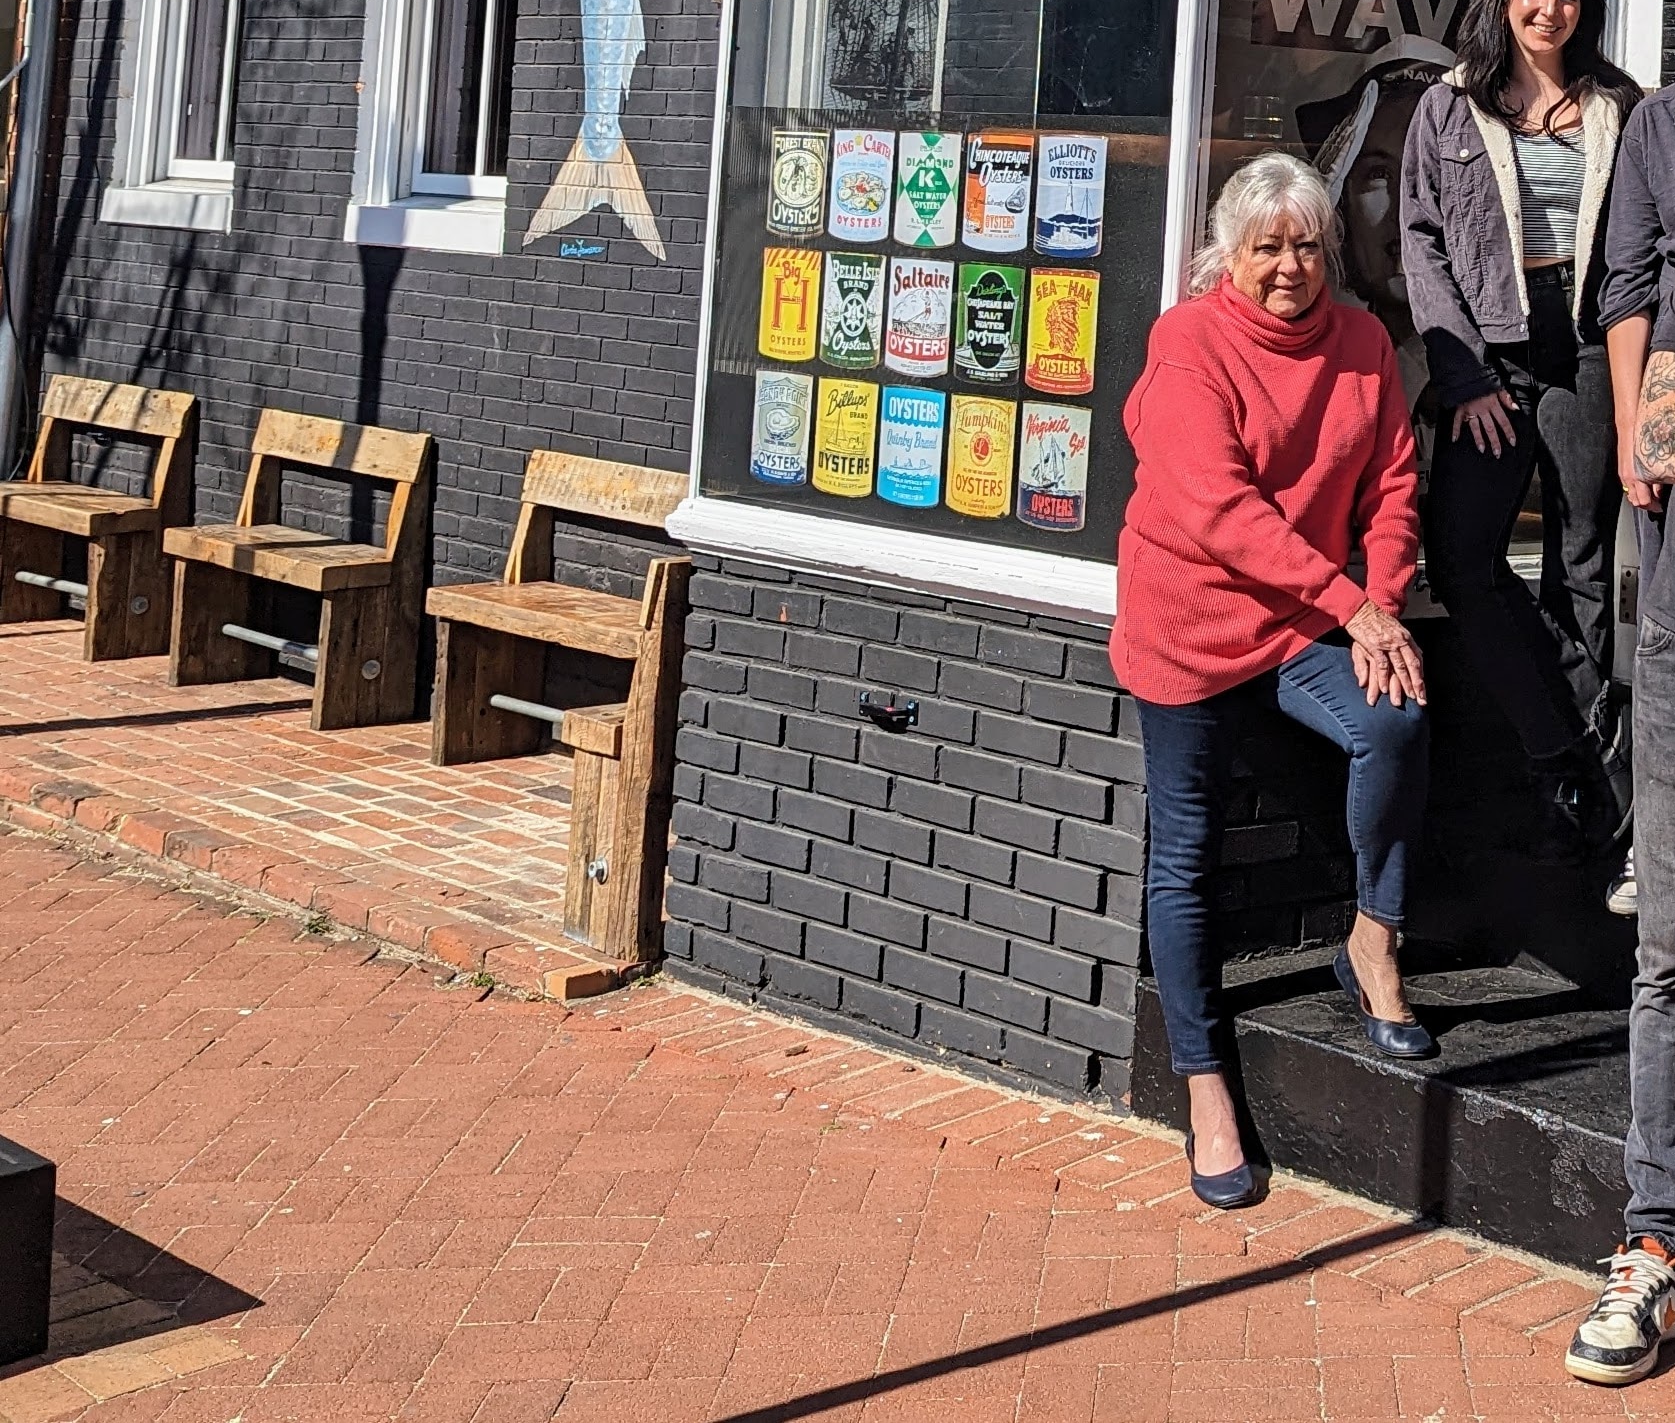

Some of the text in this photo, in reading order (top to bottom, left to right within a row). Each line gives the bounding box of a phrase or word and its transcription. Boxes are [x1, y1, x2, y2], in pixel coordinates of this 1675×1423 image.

[836, 139, 855, 158] KING
[1047, 143, 1098, 164] ELLIOTT'S
[906, 156, 954, 169] DIAMOND
[918, 170, 936, 188] K
[1050, 167, 1094, 180] OYSTERS
[772, 199, 820, 225] OYSTERS
[836, 214, 882, 228] OYSTERS
[985, 214, 1016, 229] OYSTERS
[782, 260, 801, 286] Big
[832, 259, 862, 282] BELLE
[843, 280, 869, 291] BRAND
[894, 265, 950, 296] Saltaire
[1036, 279, 1057, 302] SEA
[771, 275, 810, 332] H
[977, 312, 1003, 320] SALT
[974, 321, 1005, 331] WATER
[770, 334, 807, 346] OYSTERS
[832, 330, 872, 355] Oysters
[889, 337, 946, 357] OYSTERS
[967, 330, 1011, 349] OYSTERS
[1038, 356, 1082, 375] OYSTERS
[889, 396, 940, 423] OYSTERS
[758, 451, 800, 470] OYSTERS
[819, 451, 870, 475] OYSTERS
[955, 473, 1003, 497] OYSTERS
[1031, 494, 1074, 517] OYSTERS
